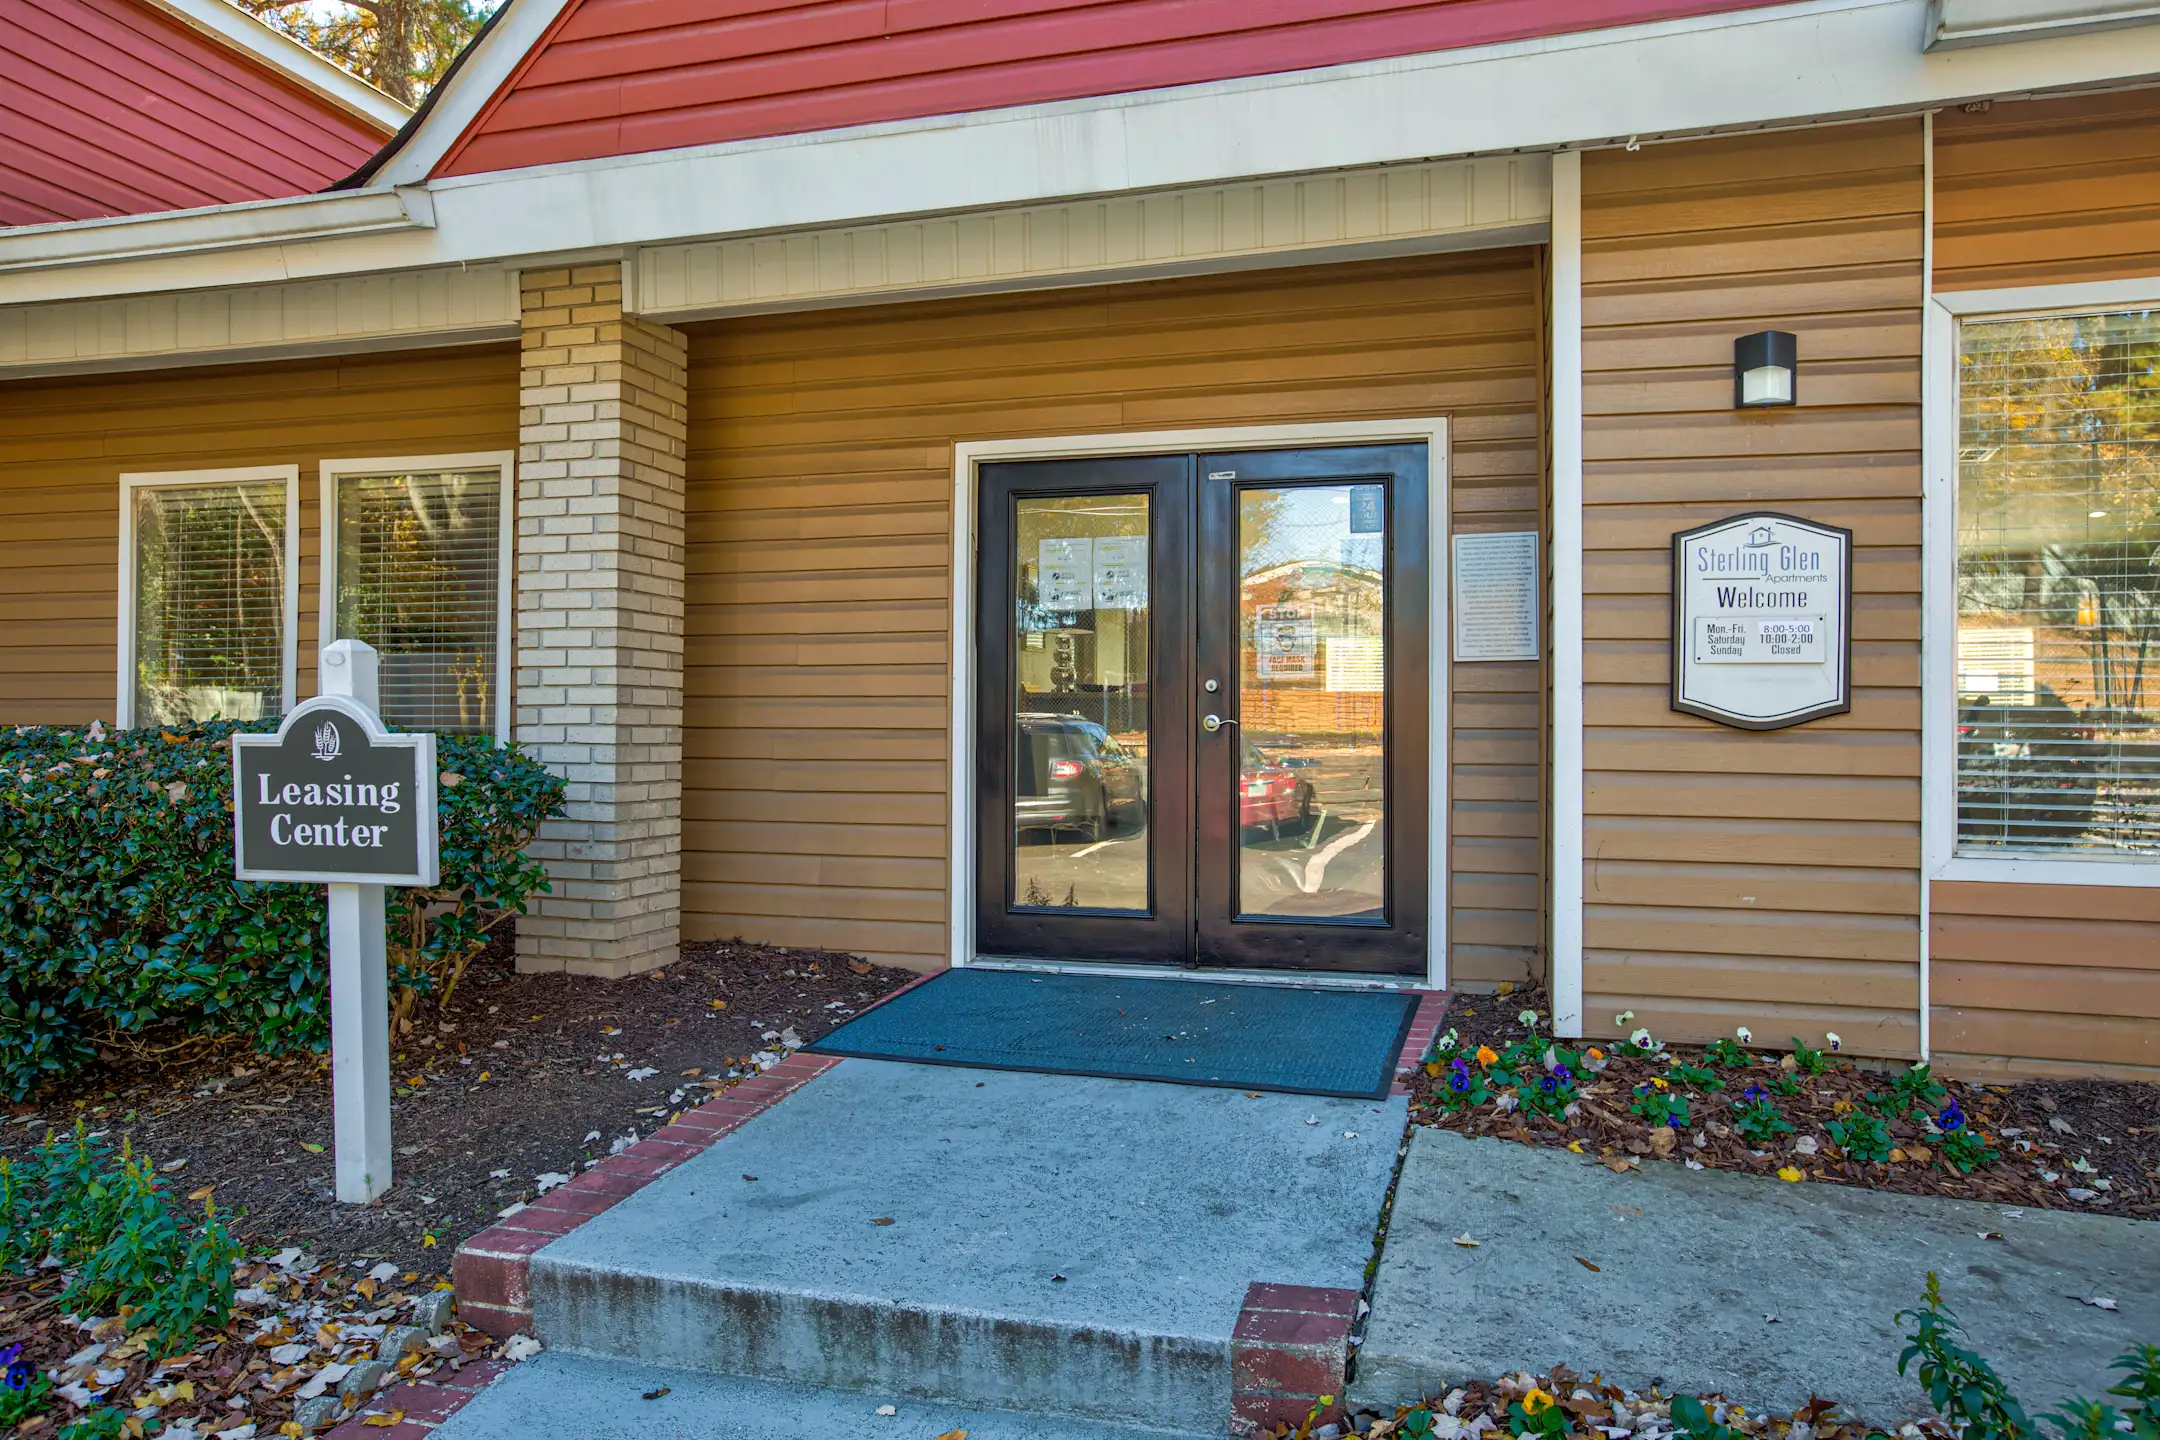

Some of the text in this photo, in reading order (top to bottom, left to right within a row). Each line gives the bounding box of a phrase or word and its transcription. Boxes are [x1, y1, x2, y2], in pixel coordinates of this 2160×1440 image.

[1698, 545, 1820, 576] Sterling Glen
[1765, 573, 1828, 584] Apartments
[1717, 586, 1807, 609] Welcome
[1268, 608, 1304, 620] STOP
[1763, 624, 1810, 634] 8:00-5:00
[1707, 633, 1813, 645] Saturday 10:00-2:00
[1710, 645, 1801, 656] Sunday Closed
[258, 773, 401, 815] Leasing
[270, 813, 389, 848] Center
